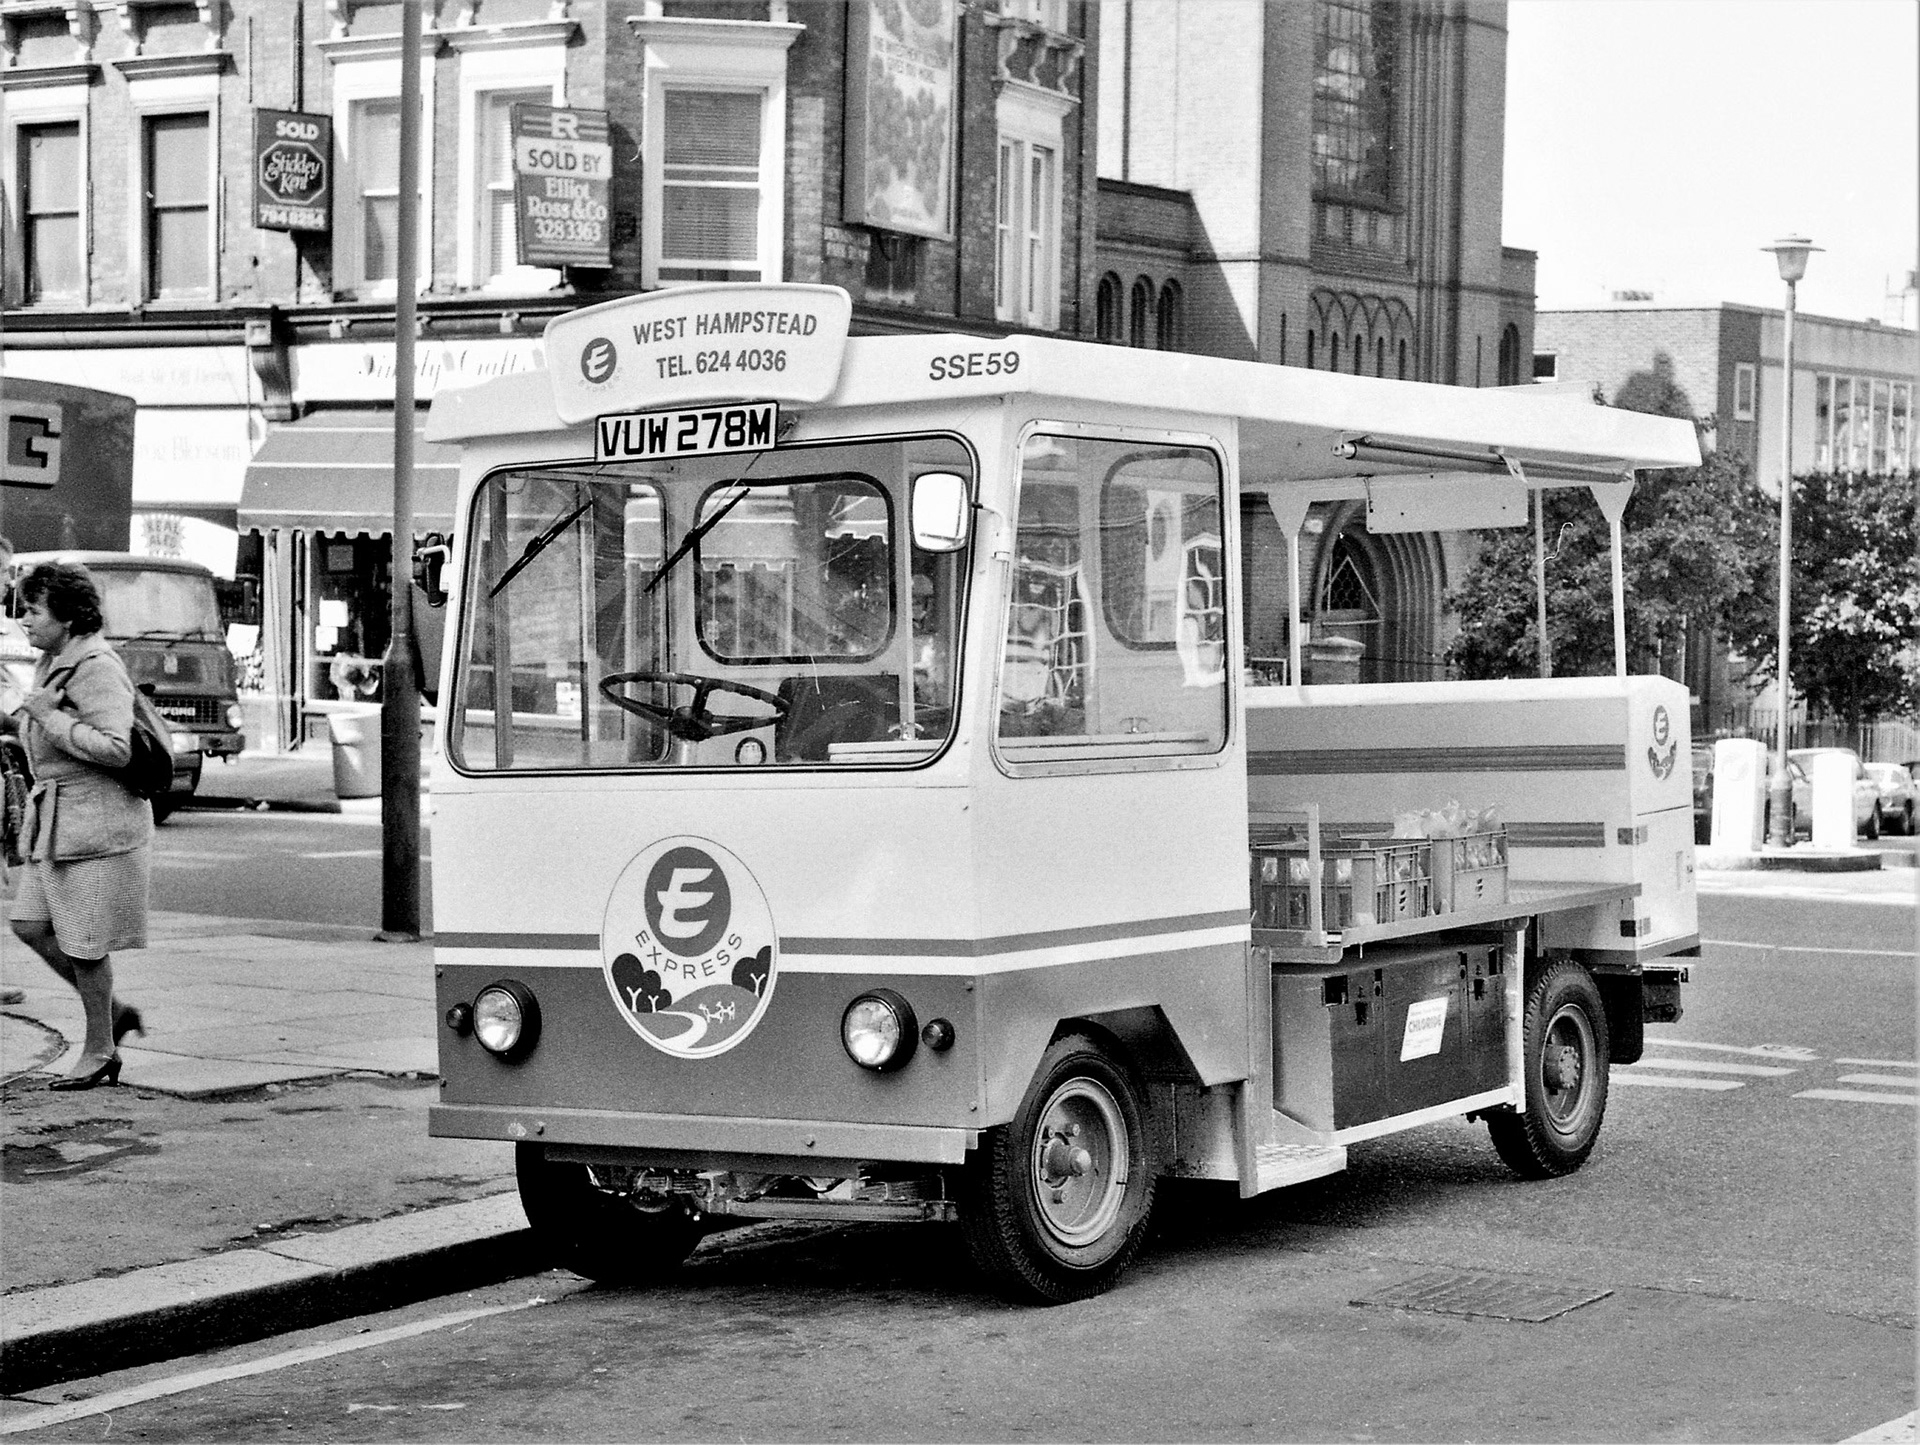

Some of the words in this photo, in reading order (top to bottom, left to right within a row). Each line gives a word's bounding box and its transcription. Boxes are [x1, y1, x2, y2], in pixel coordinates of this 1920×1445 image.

[276, 119, 320, 140] SOLD
[528, 148, 577, 171] SOLD
[583, 153, 601, 173] BY
[632, 316, 688, 345] WEST
[695, 310, 818, 337] HAMPSTEAD
[656, 354, 692, 380] TEL.
[696, 350, 731, 374] 624
[736, 349, 787, 373] 4036
[929, 350, 1020, 381] SSE59
[601, 416, 669, 457] VUW
[677, 407, 772, 452] 278M
[634, 929, 743, 980] EXPRESS
